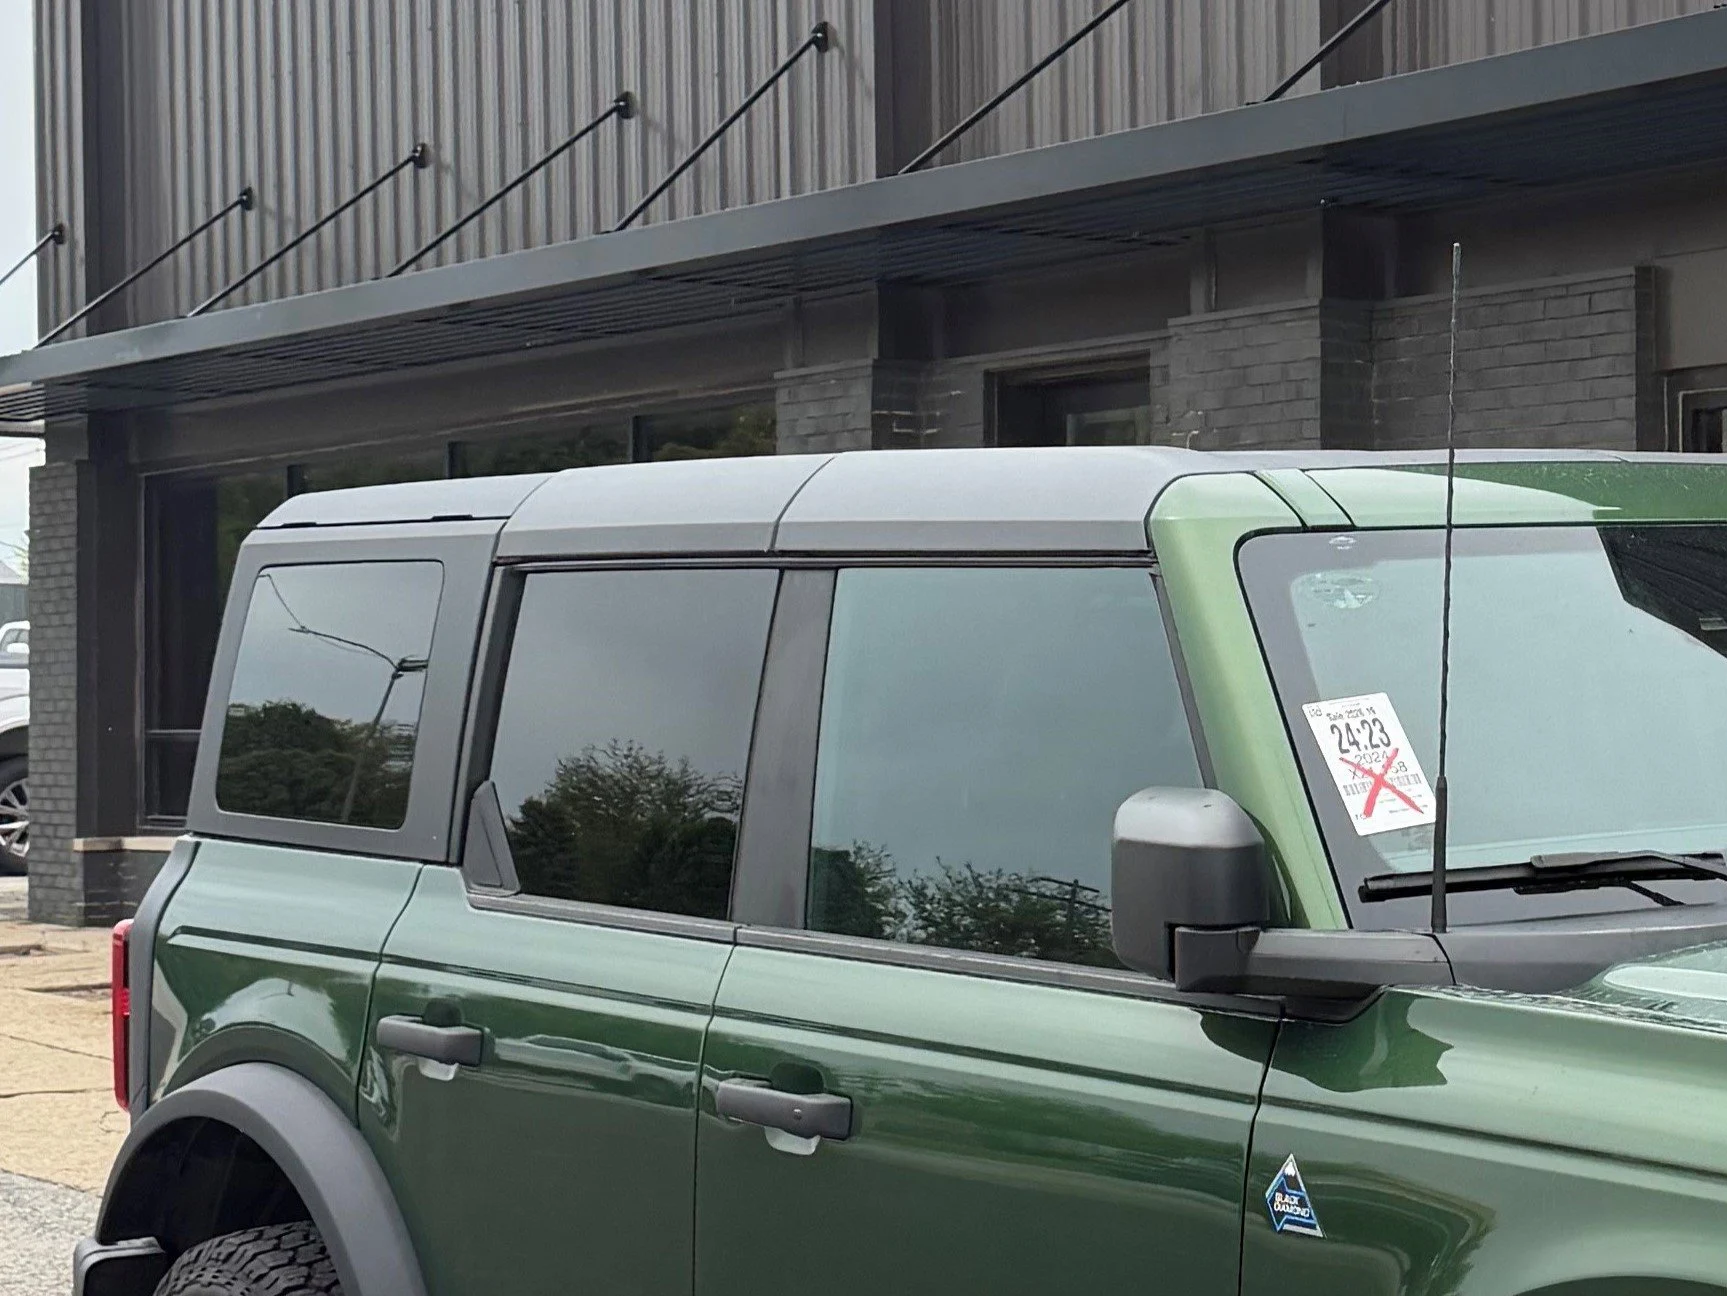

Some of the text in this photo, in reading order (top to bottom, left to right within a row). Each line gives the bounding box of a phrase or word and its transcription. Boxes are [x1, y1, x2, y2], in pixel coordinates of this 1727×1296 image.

[1330, 717, 1391, 754] 24:23
[1275, 1192, 1300, 1205] BLACK
[1273, 1202, 1310, 1217] DIAMOND
